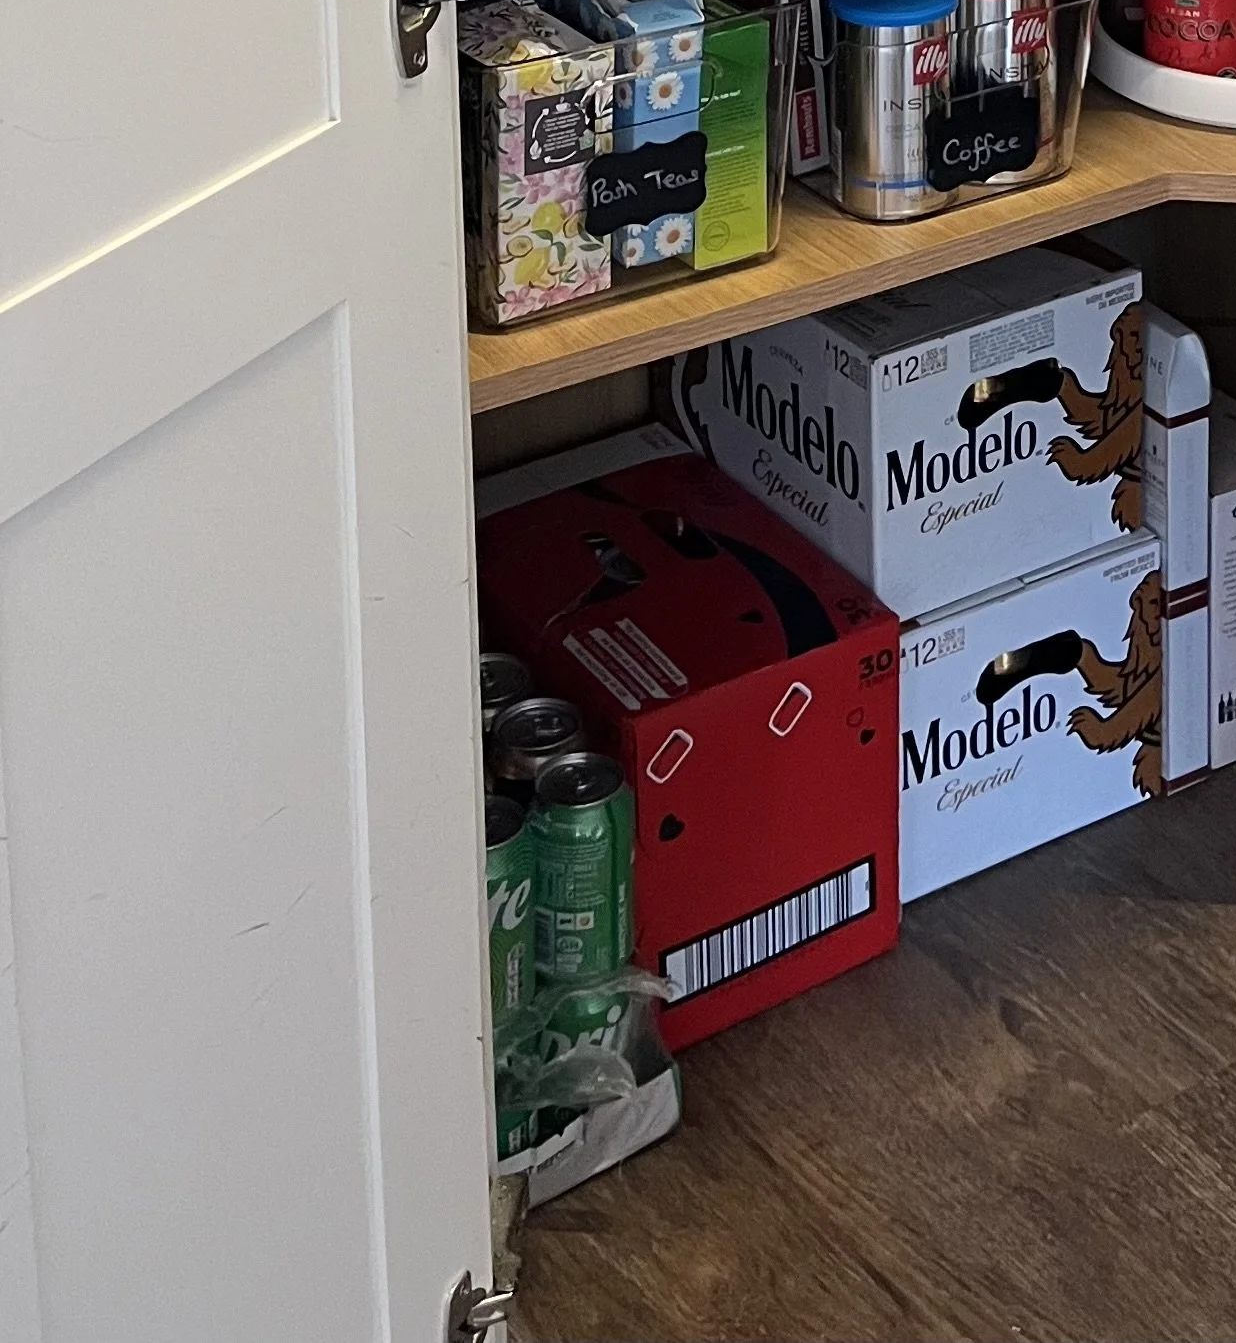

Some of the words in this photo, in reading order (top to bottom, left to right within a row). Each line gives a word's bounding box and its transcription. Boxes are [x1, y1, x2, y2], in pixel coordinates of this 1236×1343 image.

[1015, 17, 1046, 47] illy
[916, 44, 948, 79] illy
[943, 133, 1021, 172] Coffee
[592, 177, 637, 208] Posh
[644, 168, 699, 190] Teas
[832, 345, 850, 379] 12
[892, 355, 919, 387] 12
[721, 338, 860, 501] Modelo
[886, 410, 1037, 513] Modelo
[752, 448, 829, 527] Especial
[920, 480, 1005, 536] Especial
[859, 648, 894, 680] 30
[909, 637, 938, 668] 12
[901, 684, 1057, 792] Modelo
[936, 754, 1024, 814] Especial
